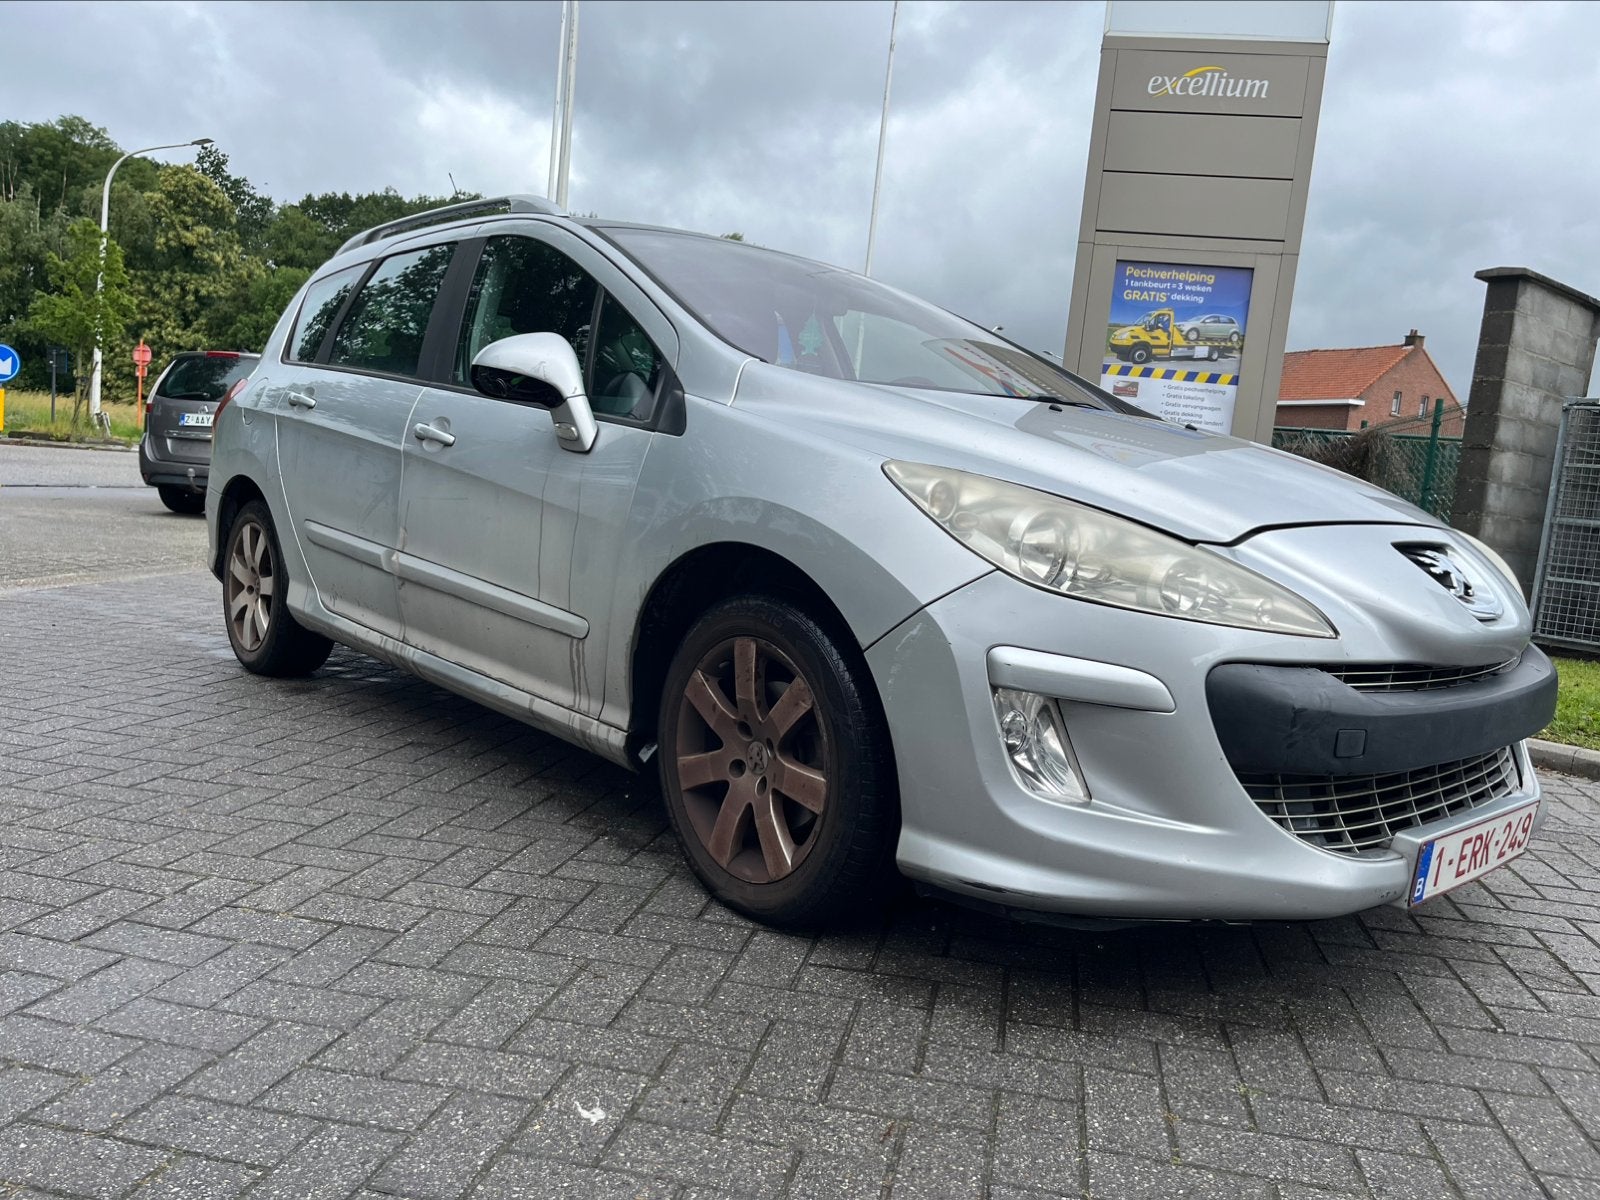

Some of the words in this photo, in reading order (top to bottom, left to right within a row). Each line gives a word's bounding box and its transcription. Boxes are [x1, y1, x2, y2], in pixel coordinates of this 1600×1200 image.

[1147, 72, 1269, 98] excellium
[1126, 266, 1215, 284] Pechverhelping
[1130, 280, 1170, 289] tankbeurt
[1185, 284, 1212, 292] weken
[1171, 293, 1204, 304] dekking
[1433, 812, 1533, 888] 1-ERK-249
[1414, 877, 1424, 897] B
